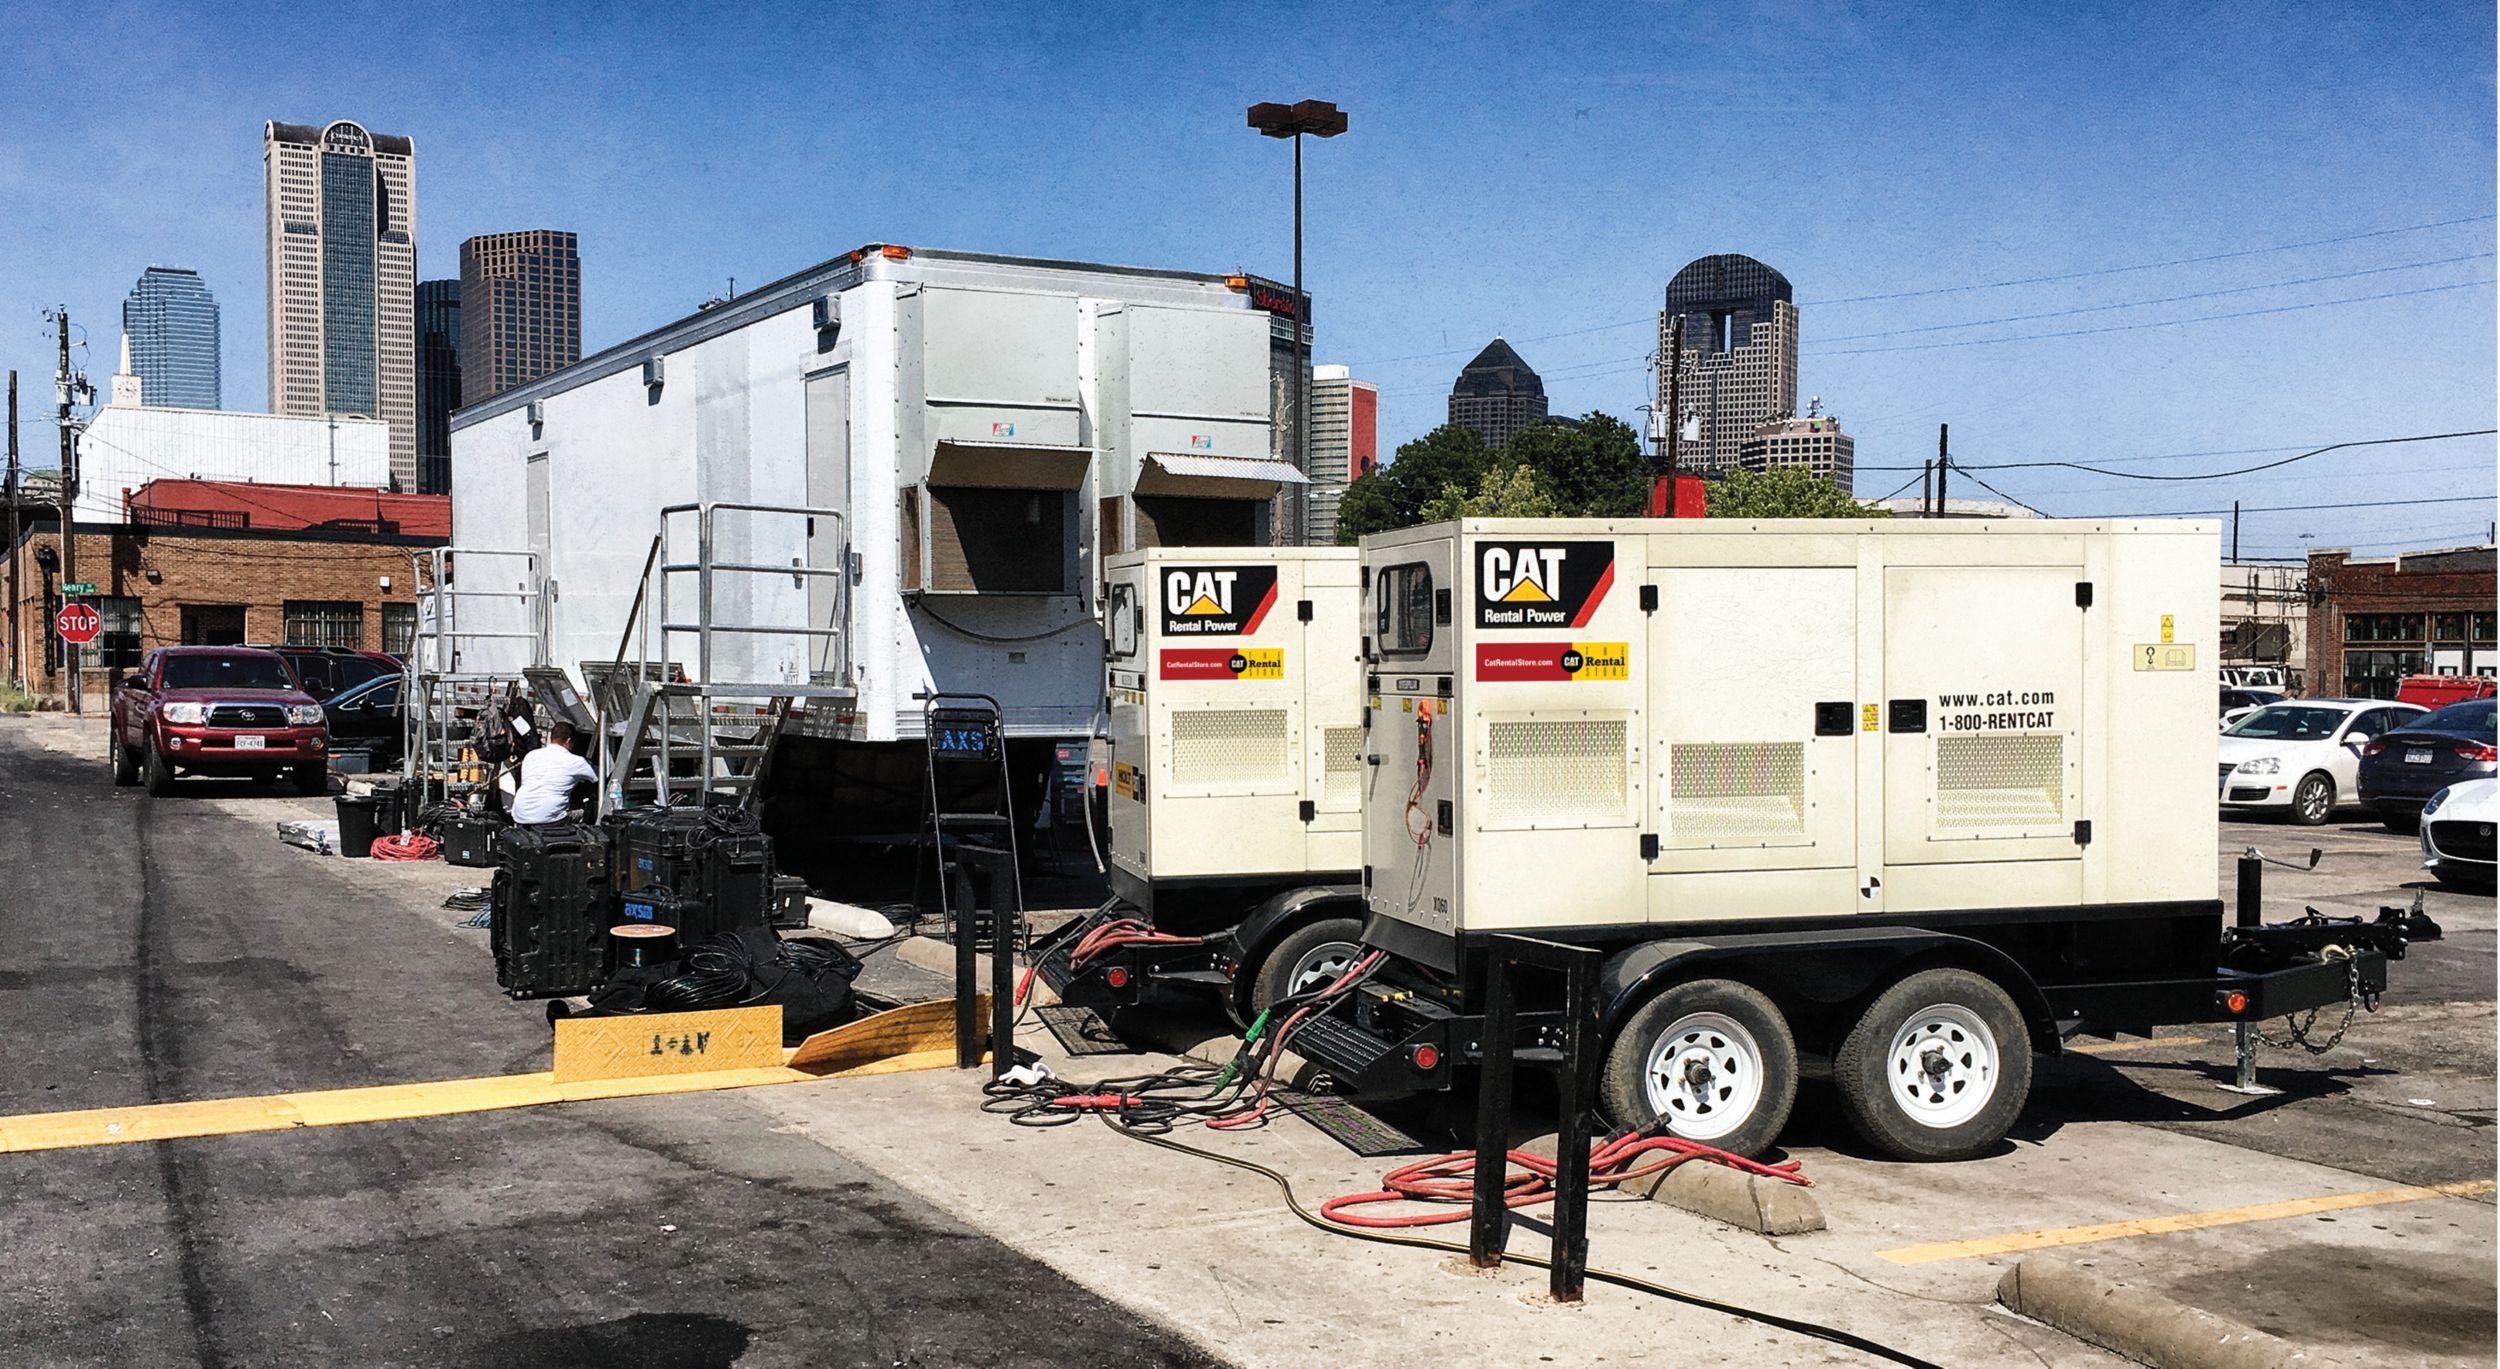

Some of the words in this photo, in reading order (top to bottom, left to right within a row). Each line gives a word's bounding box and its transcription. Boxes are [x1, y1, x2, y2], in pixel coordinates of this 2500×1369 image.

[1483, 547, 1566, 602] CAT
[1167, 571, 1238, 616] CAT
[1484, 608, 1523, 623] Rental
[1527, 608, 1566, 623] Power
[60, 615, 98, 631] STOP
[1169, 619, 1202, 632] Rental
[1205, 619, 1238, 632] Power
[1231, 659, 1244, 668] CAT
[1248, 659, 1281, 668] Rental
[1484, 658, 1553, 667] CatRentalStore.com
[1563, 656, 1580, 667] CAT
[1585, 656, 1625, 667] Rental
[1938, 690, 2055, 707] www.cat.com
[1939, 711, 2055, 731] 1-800-RENTCAT
